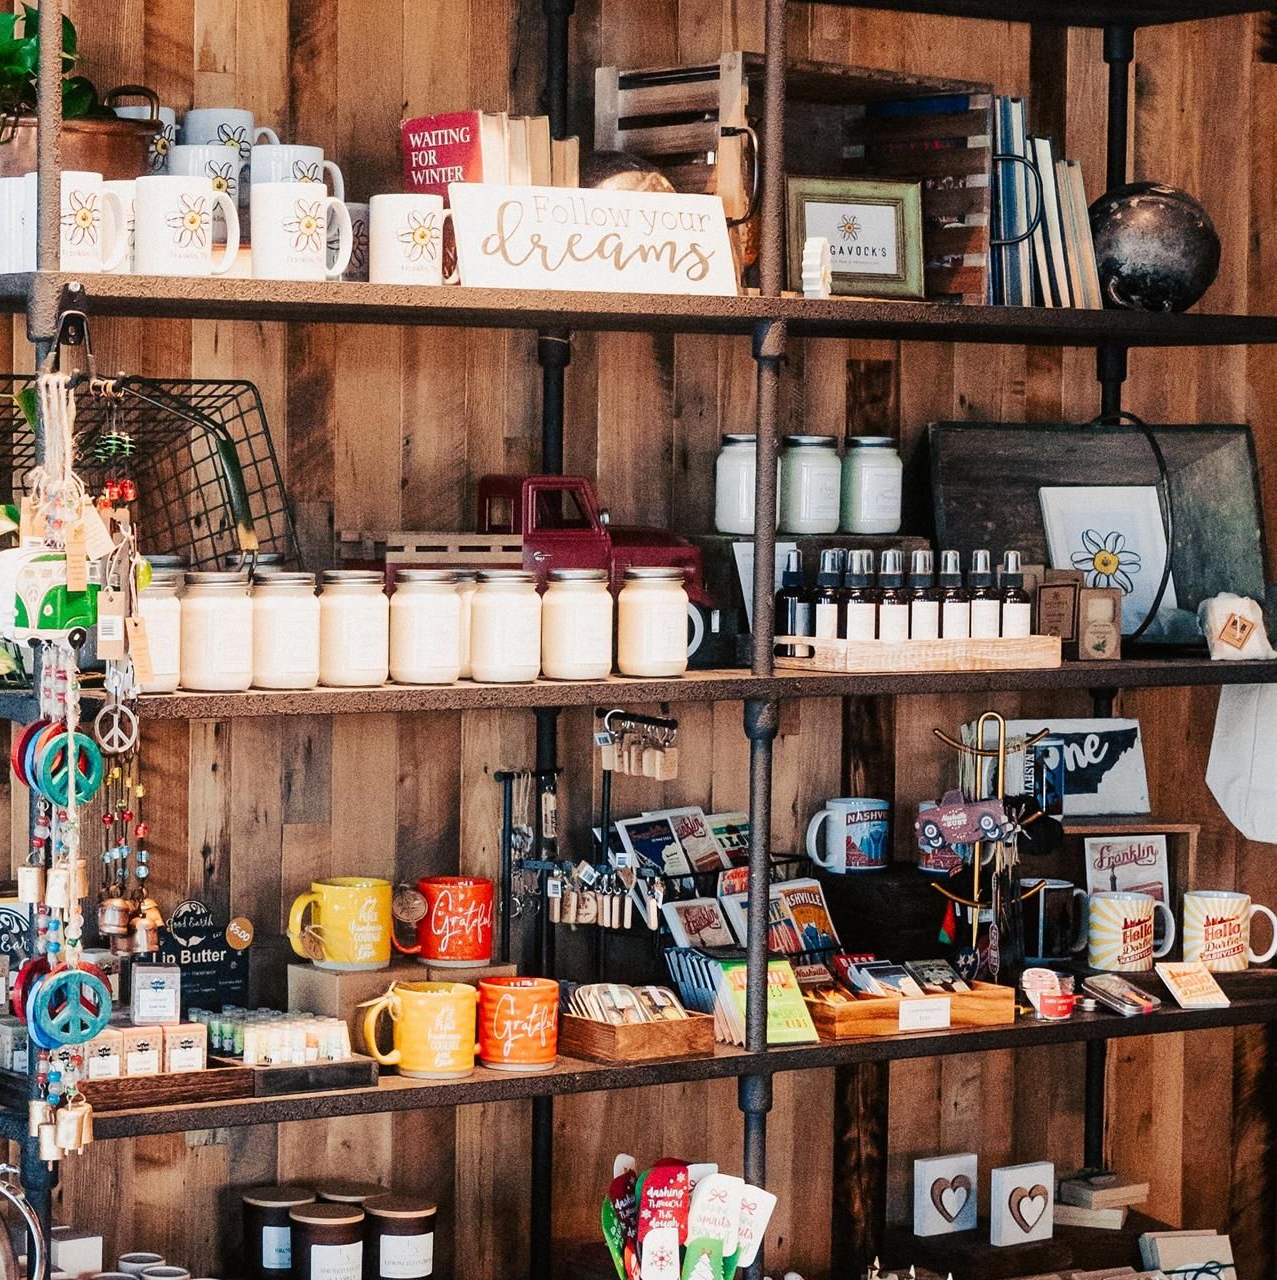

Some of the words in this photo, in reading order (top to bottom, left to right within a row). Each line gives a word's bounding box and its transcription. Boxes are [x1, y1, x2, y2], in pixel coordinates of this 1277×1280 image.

[409, 127, 471, 148] WAITING
[411, 150, 438, 167] FOR
[411, 166, 465, 185] WINTER
[531, 195, 630, 228] Follow
[639, 209, 711, 236] your
[481, 200, 715, 282] dreams
[829, 244, 887, 257] GAVOCK'S
[1094, 842, 1159, 871] Franklin
[786, 893, 822, 907] ASHVILLE
[431, 890, 493, 952] Grateful
[229, 922, 251, 941] $5.00
[1122, 923, 1153, 944] Hello
[1204, 922, 1241, 942] Hello
[1, 933, 29, 951] Ear
[180, 949, 226, 964] Butter
[493, 993, 559, 1057] Grateful
[646, 1186, 685, 1199] dashing
